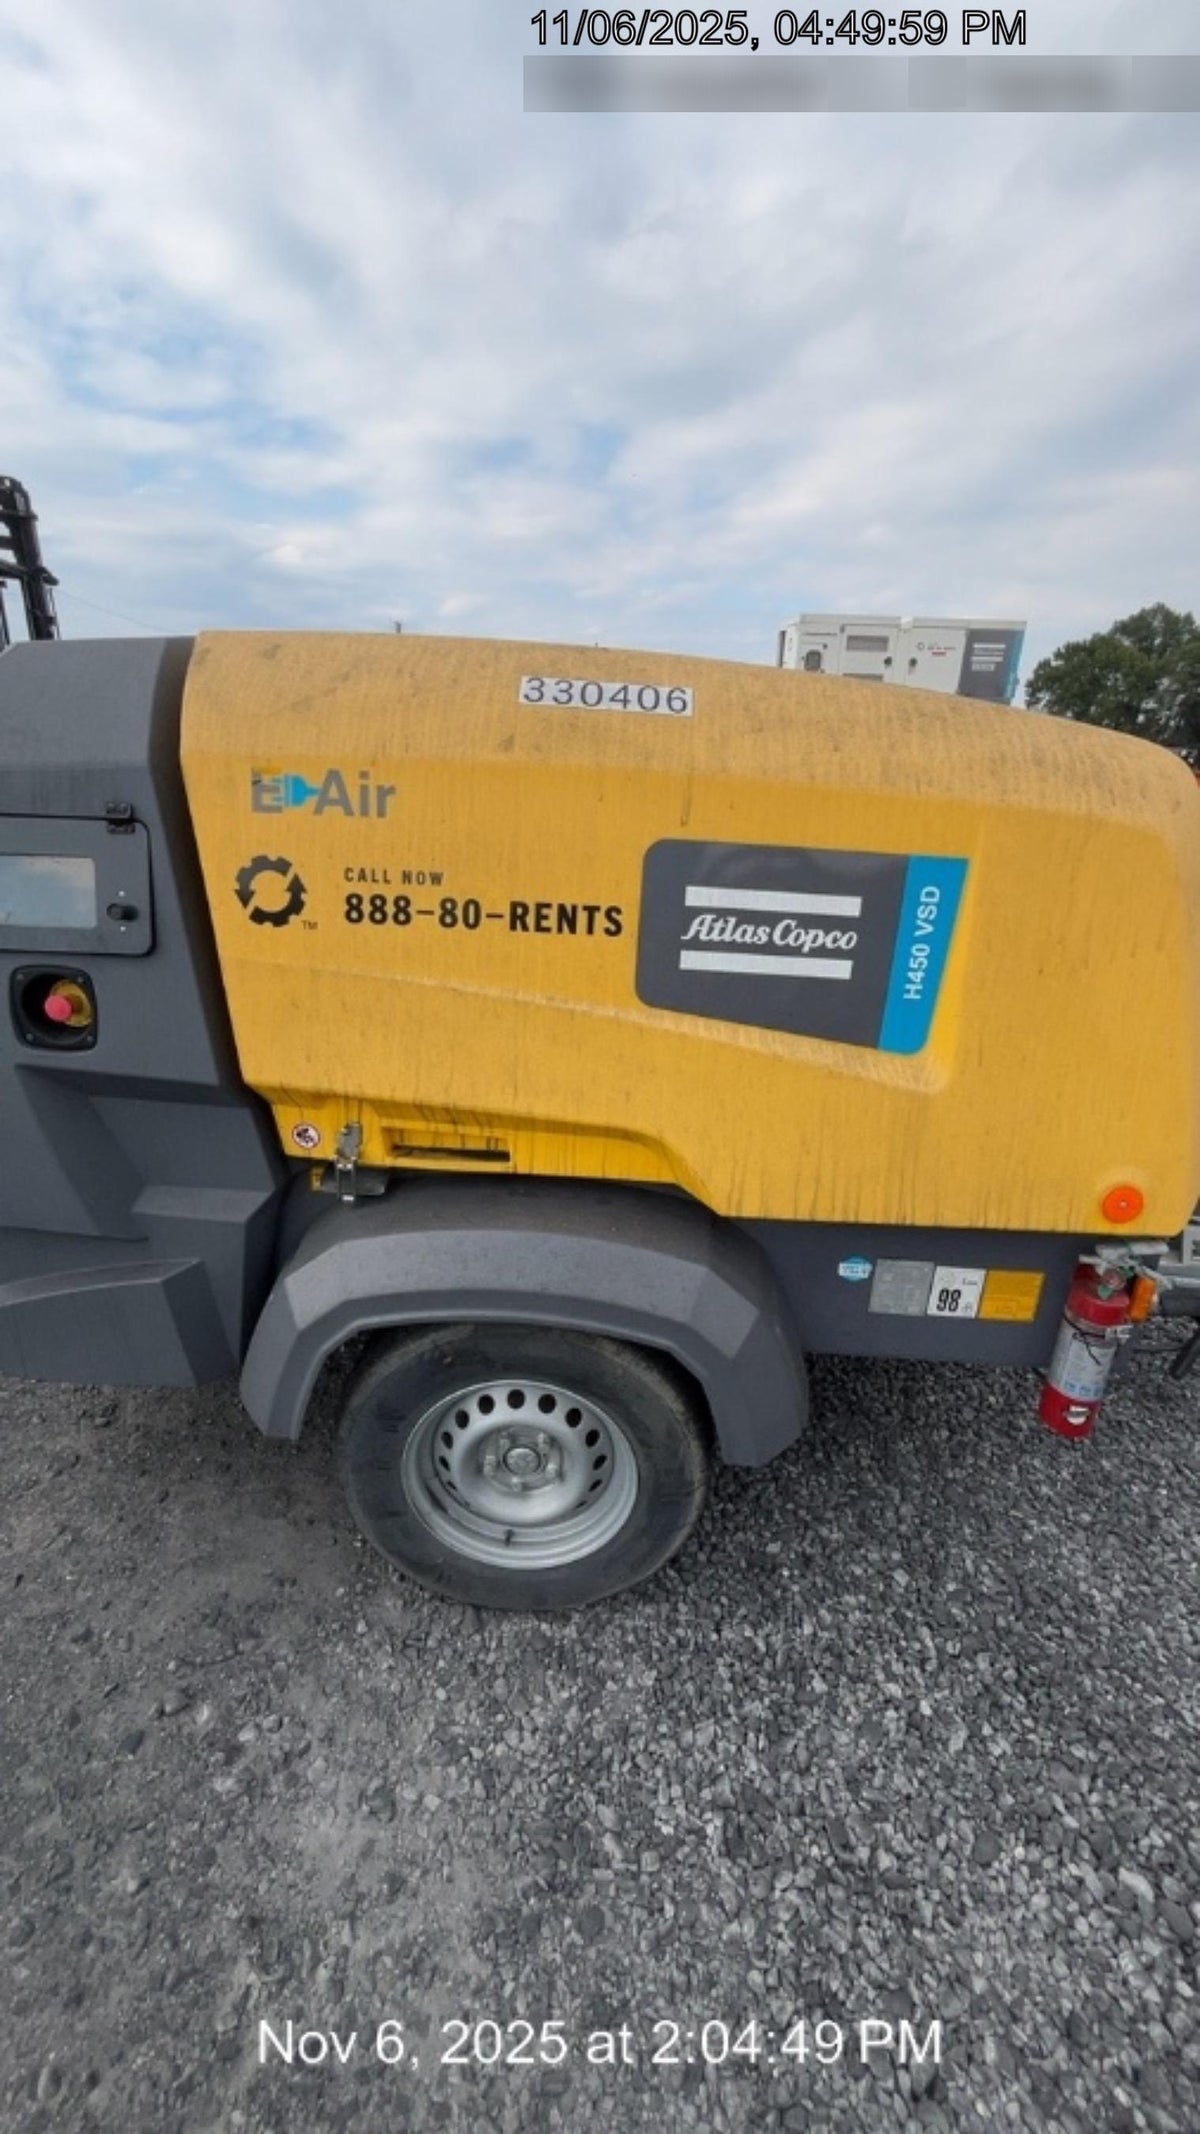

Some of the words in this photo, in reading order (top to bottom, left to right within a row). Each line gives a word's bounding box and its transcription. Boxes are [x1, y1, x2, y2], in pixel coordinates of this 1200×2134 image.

[523, 677, 688, 713] 330406
[344, 868, 392, 885] CALL
[402, 870, 444, 887] NOW
[344, 892, 624, 938] 888-80-RENTS
[914, 885, 941, 938] VSD
[680, 914, 770, 944] Atlas
[772, 919, 858, 953] Copco
[903, 943, 931, 1000] H450
[936, 1288, 962, 1312] 98
